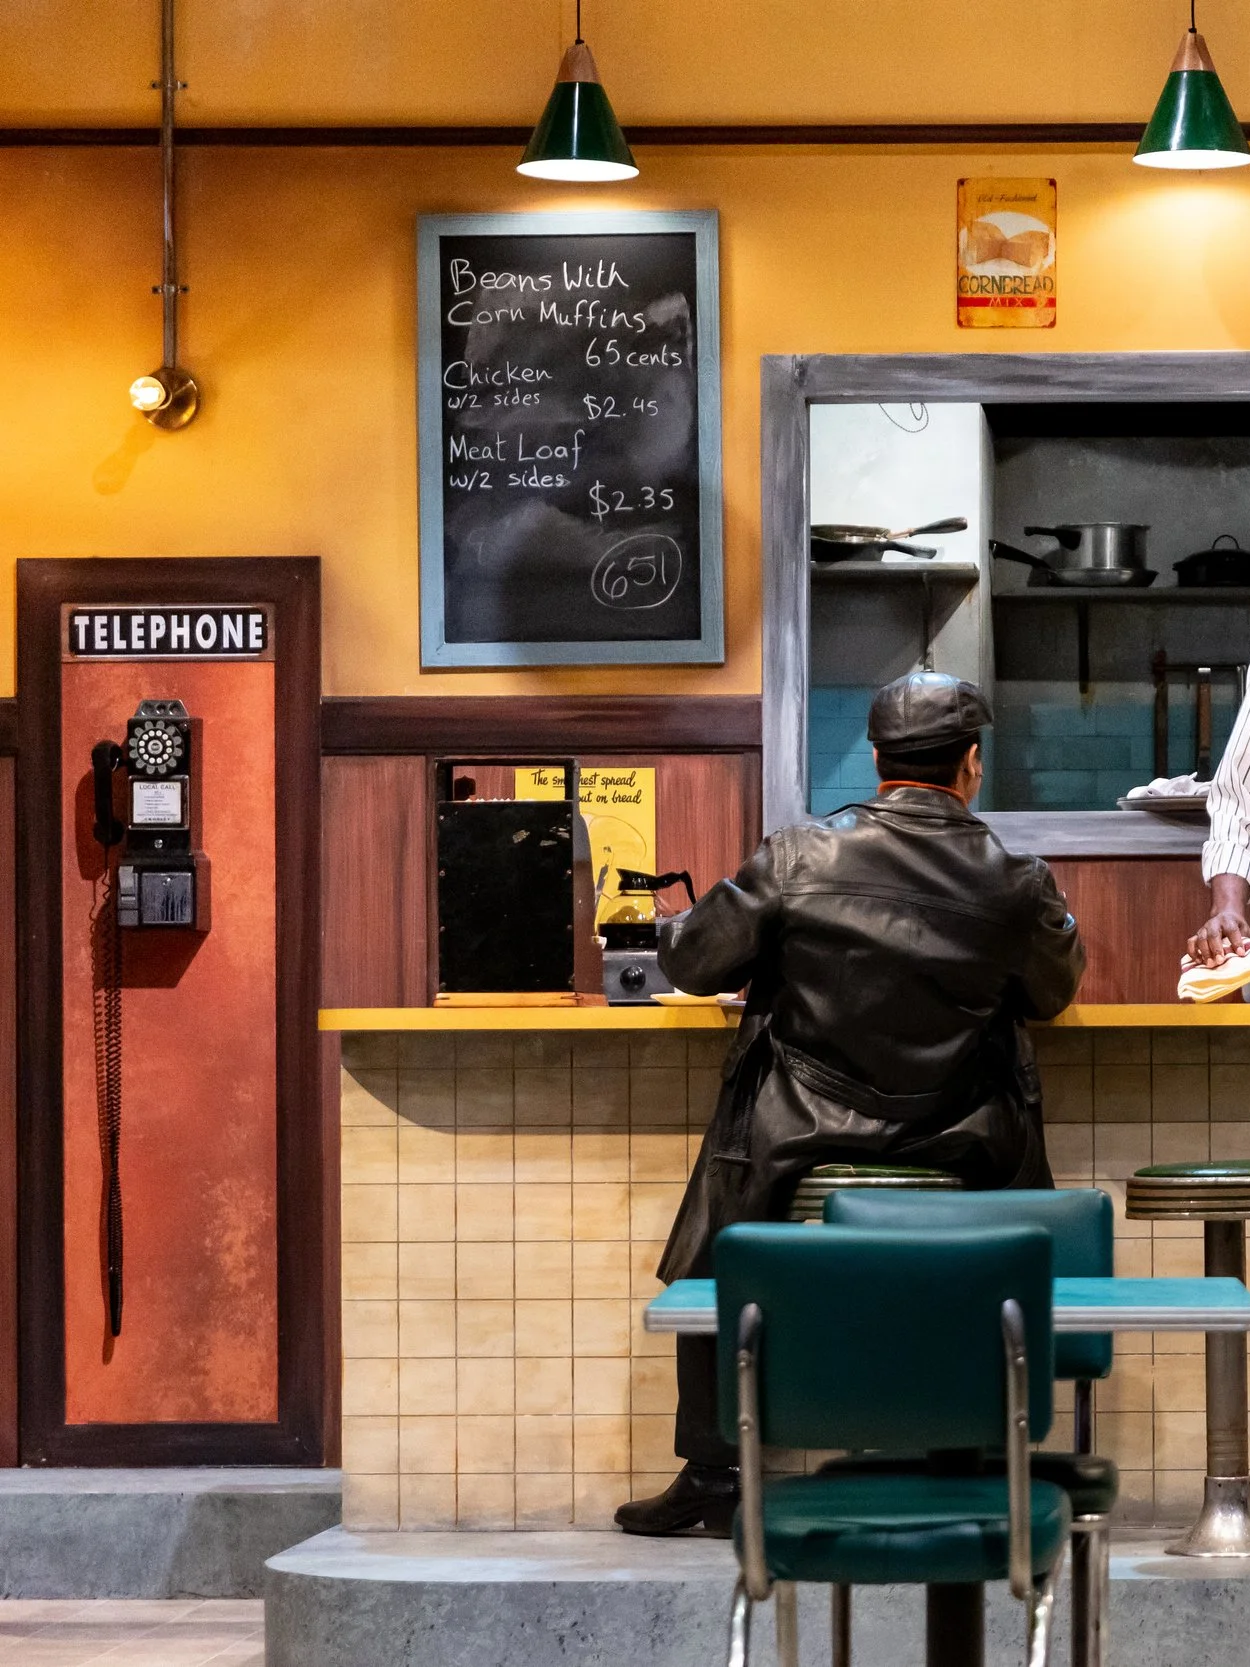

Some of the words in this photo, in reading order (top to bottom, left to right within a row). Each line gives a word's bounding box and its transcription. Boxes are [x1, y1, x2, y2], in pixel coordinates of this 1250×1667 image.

[450, 258, 552, 296] Beans
[563, 259, 629, 291] With
[958, 275, 1054, 294] CORNBREAD
[448, 301, 526, 326] Corn
[539, 299, 647, 333] Muffins
[989, 296, 1023, 307] MIX
[585, 337, 620, 366] 65
[626, 344, 682, 367] cents
[443, 360, 553, 390] Chicken
[447, 396, 482, 410] w/2
[493, 388, 541, 406] sides
[583, 392, 659, 421] $2.45
[450, 431, 507, 464] Meat
[518, 429, 586, 470] Loaf
[450, 470, 493, 491] w/2
[508, 465, 565, 488] sides
[588, 480, 675, 522] $2.35
[602, 552, 667, 600] 651
[74, 613, 263, 650] TELEPHONE
[531, 768, 549, 786] The
[600, 771, 637, 790] spread
[595, 795, 608, 804] on
[611, 789, 642, 804] bread
